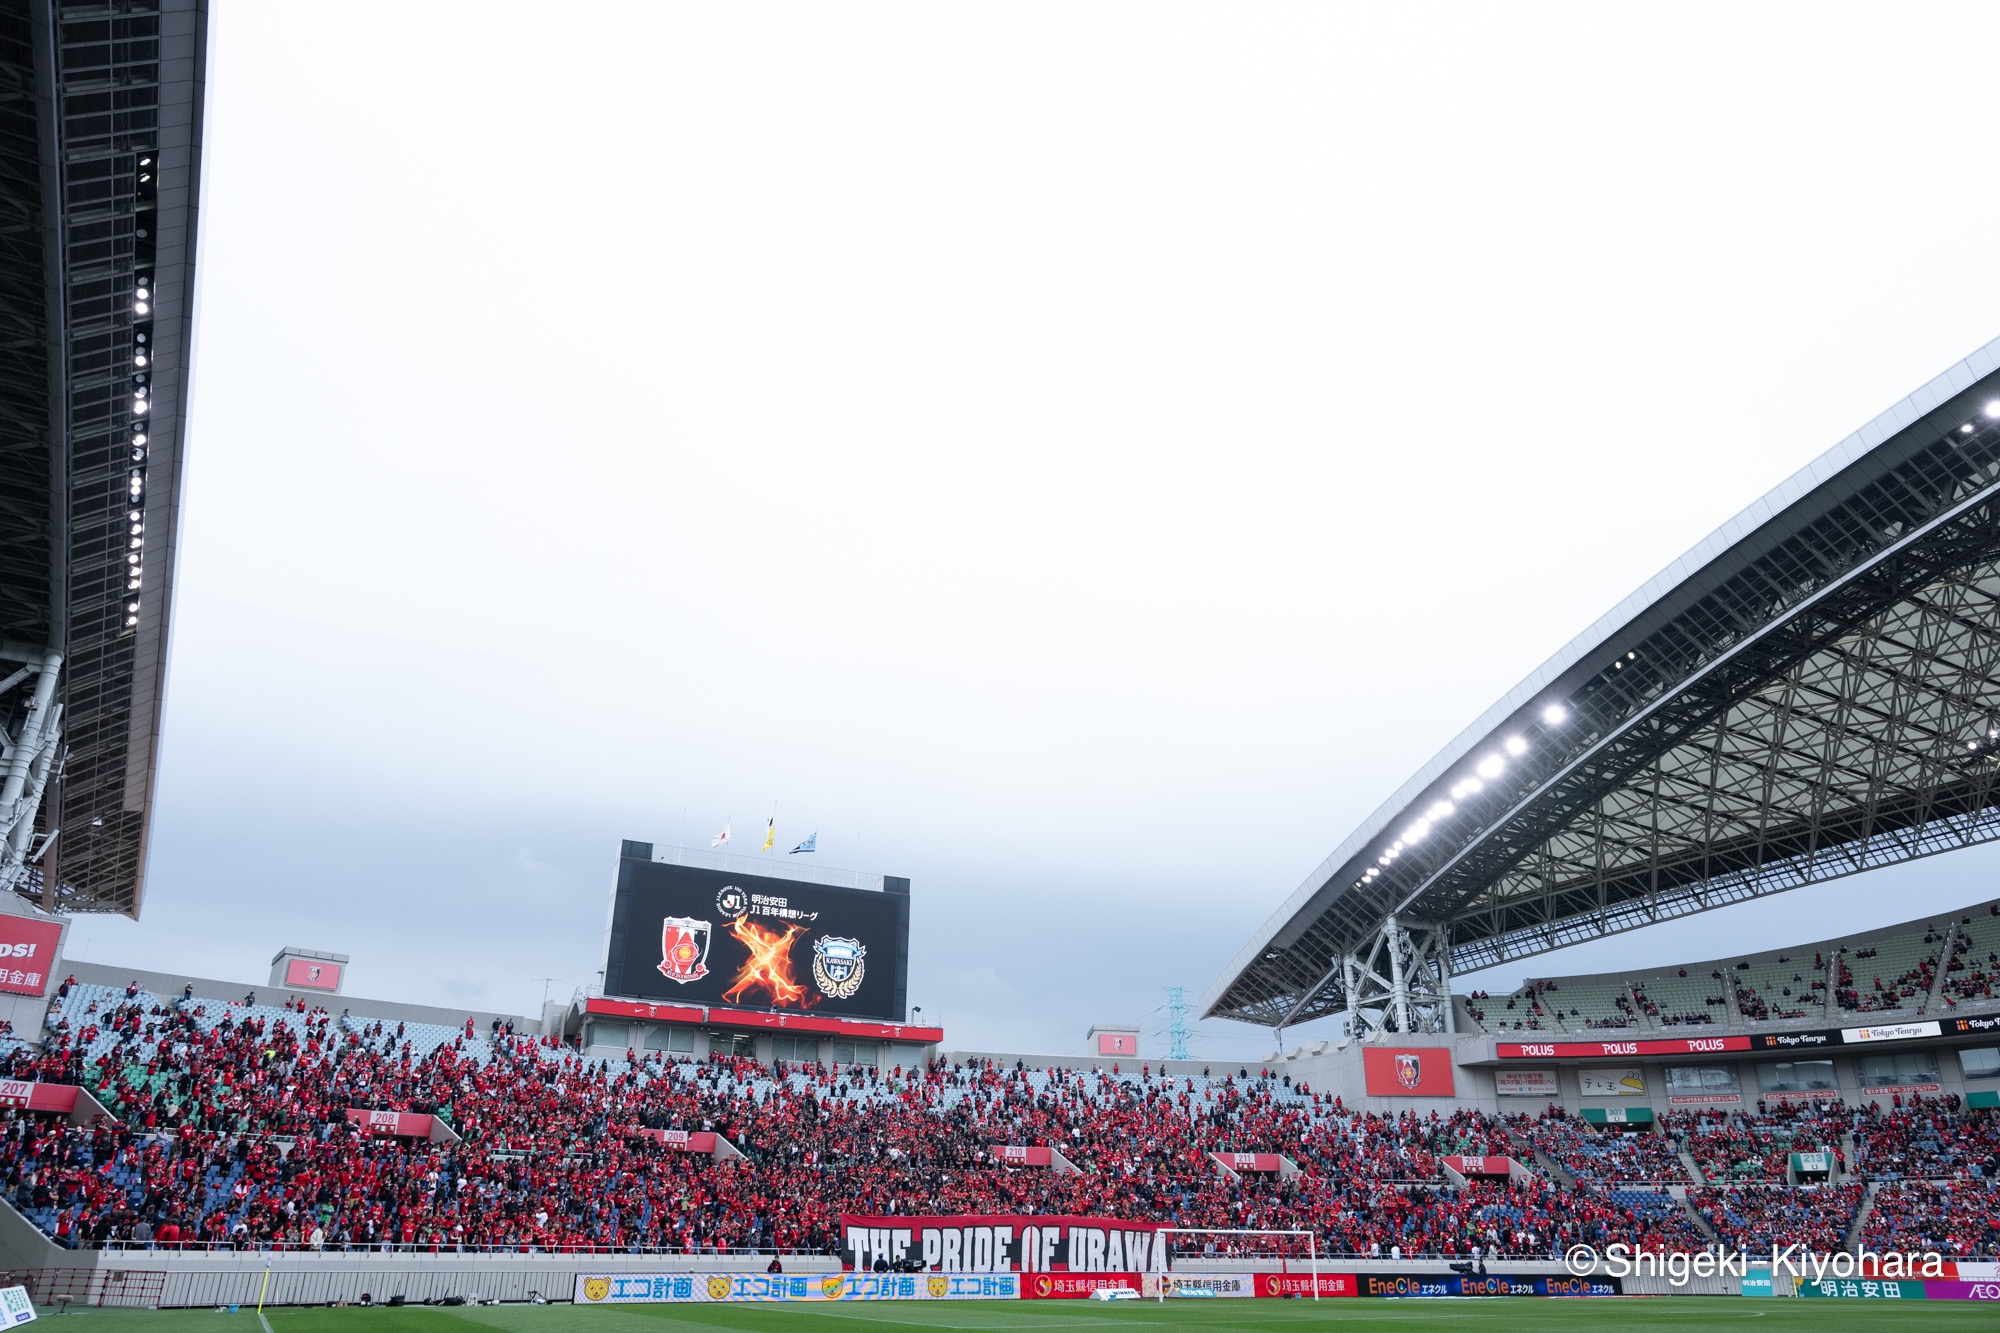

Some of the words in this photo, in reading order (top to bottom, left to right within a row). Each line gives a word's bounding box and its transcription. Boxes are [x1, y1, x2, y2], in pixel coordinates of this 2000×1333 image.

[752, 894, 788, 908] 明治安田
[826, 958, 853, 966] KAWASAKI
[1969, 1020, 1994, 1029] Tokyo
[1871, 1029, 1895, 1038] Tokyo
[1895, 1027, 1923, 1036] Tenryu
[1688, 1039, 1724, 1051] POLUS
[1777, 1036, 1800, 1045] Tokyo
[1800, 1035, 1827, 1044] Tenryu
[1521, 1045, 1554, 1056] POLUS
[1602, 1043, 1637, 1054] POLUS
[1, 1082, 28, 1095] 207
[375, 1113, 395, 1123] 208
[668, 1132, 684, 1141] 209
[1009, 1148, 1022, 1156] 210
[1804, 1154, 1822, 1162] 213
[847, 1227, 912, 1272] THE
[922, 1226, 1013, 1272] PRIDE
[1021, 1227, 1060, 1272] OF
[1069, 1227, 1168, 1272] URAWA
[612, 1278, 693, 1299] エコ計画
[733, 1277, 808, 1298] エコ計画
[846, 1277, 915, 1296] エコ計画
[951, 1277, 1014, 1296] エコ計画
[1369, 1278, 1420, 1295] EneCle
[1422, 1284, 1448, 1295] エネクル
[1461, 1278, 1509, 1295] EneCle
[1510, 1284, 1534, 1295] エネクル
[1547, 1278, 1591, 1294] EneCle
[1592, 1285, 1615, 1294] エネクル
[1821, 1280, 1901, 1298] 明治安田
